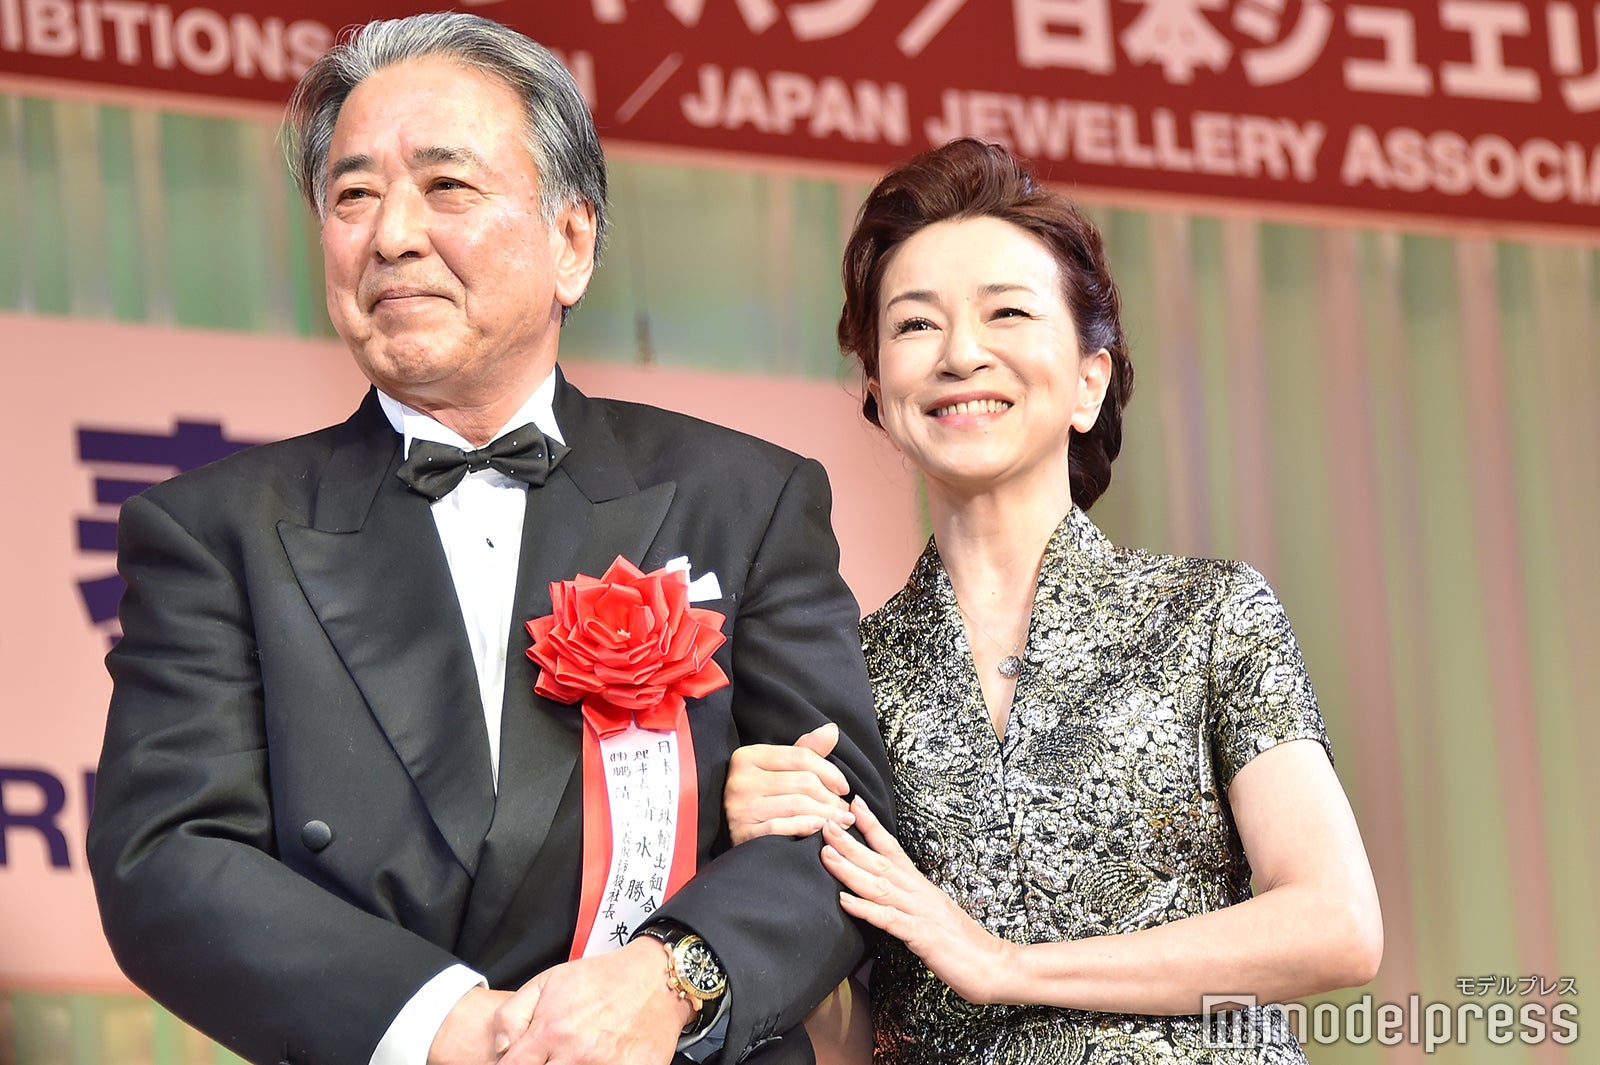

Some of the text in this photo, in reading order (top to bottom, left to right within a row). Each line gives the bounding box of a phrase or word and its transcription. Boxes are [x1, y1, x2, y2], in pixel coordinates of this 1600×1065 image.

[680, 64, 909, 146] JAPAN
[924, 88, 1326, 183] JEWELLERY
[1341, 123, 1600, 206] ASSOCI
